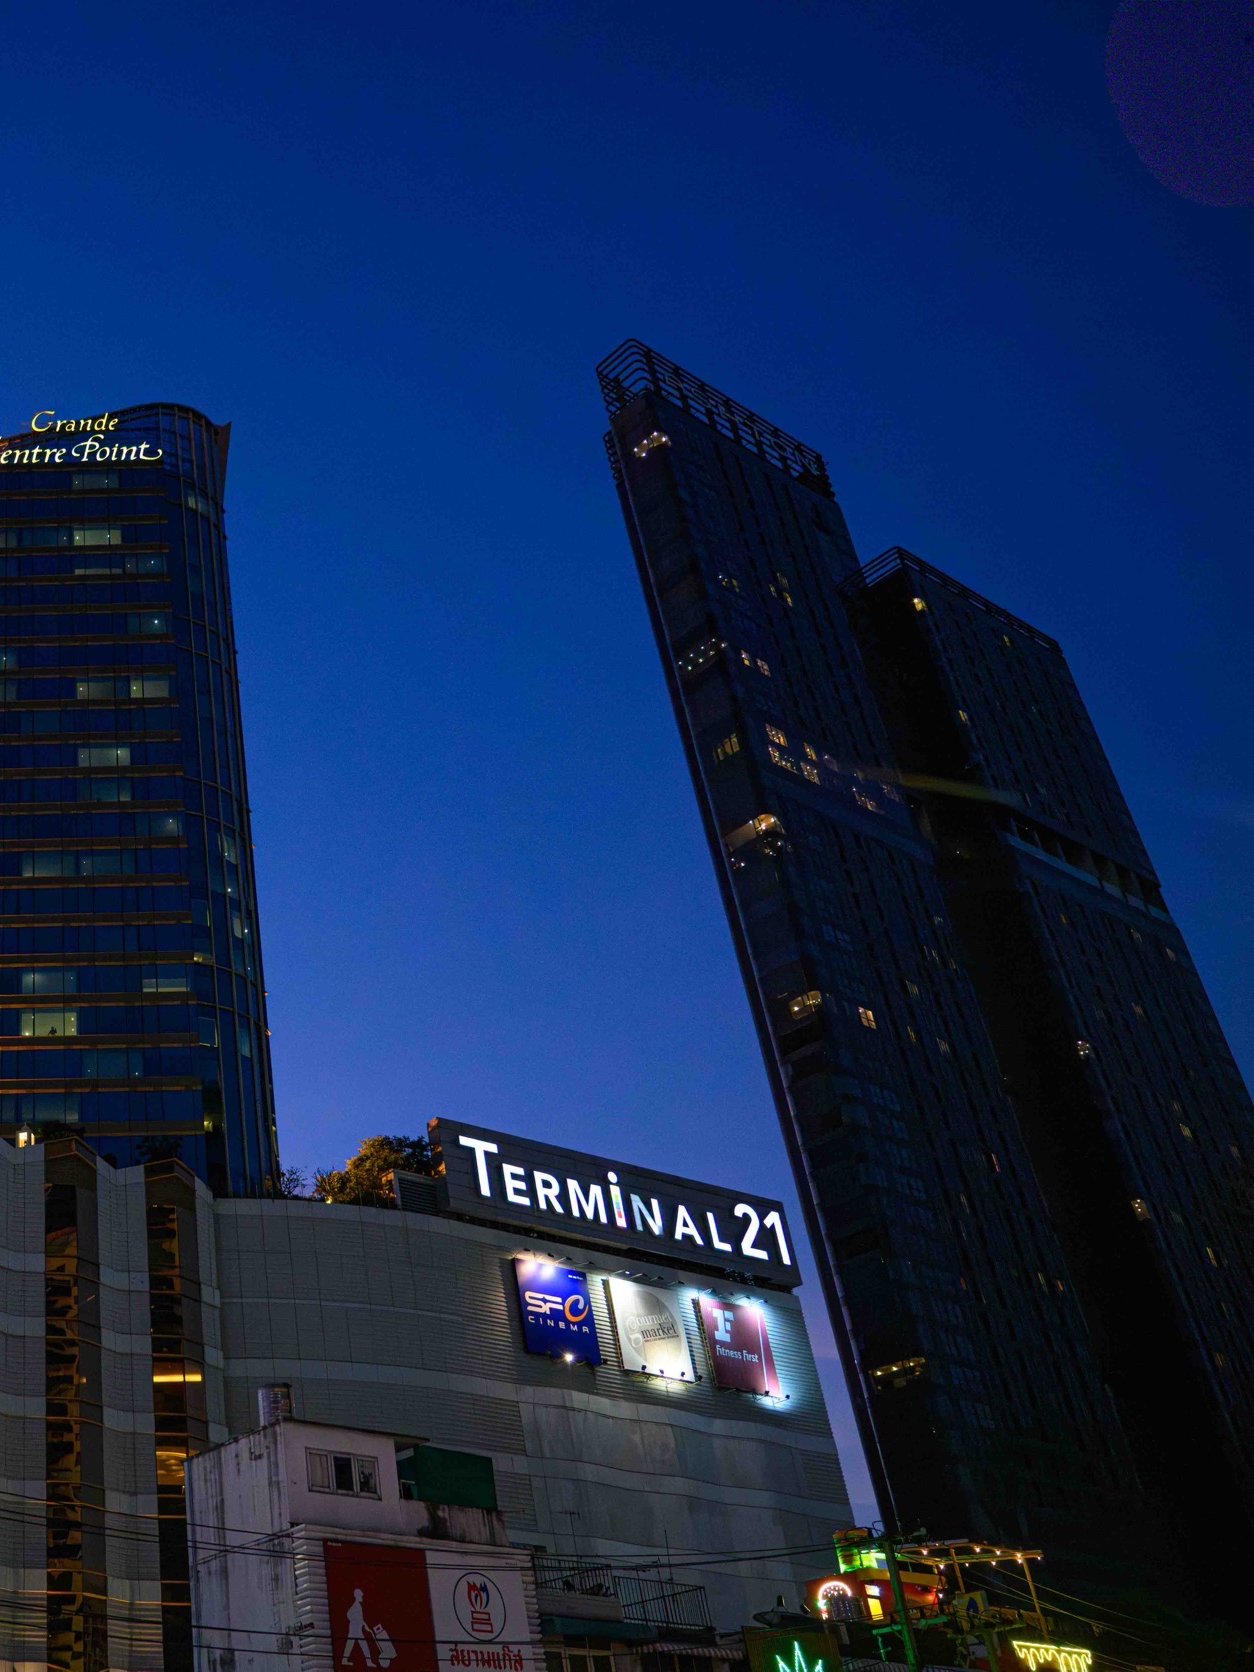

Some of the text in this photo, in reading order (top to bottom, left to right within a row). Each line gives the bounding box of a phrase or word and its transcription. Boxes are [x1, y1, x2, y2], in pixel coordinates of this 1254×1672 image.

[31, 410, 119, 433] Grande
[71, 434, 163, 462] Point
[528, 1315, 590, 1334] CINEMA
[625, 1312, 672, 1348] gourmet
[640, 1321, 678, 1339] market
[716, 1344, 759, 1363] Fitness First
